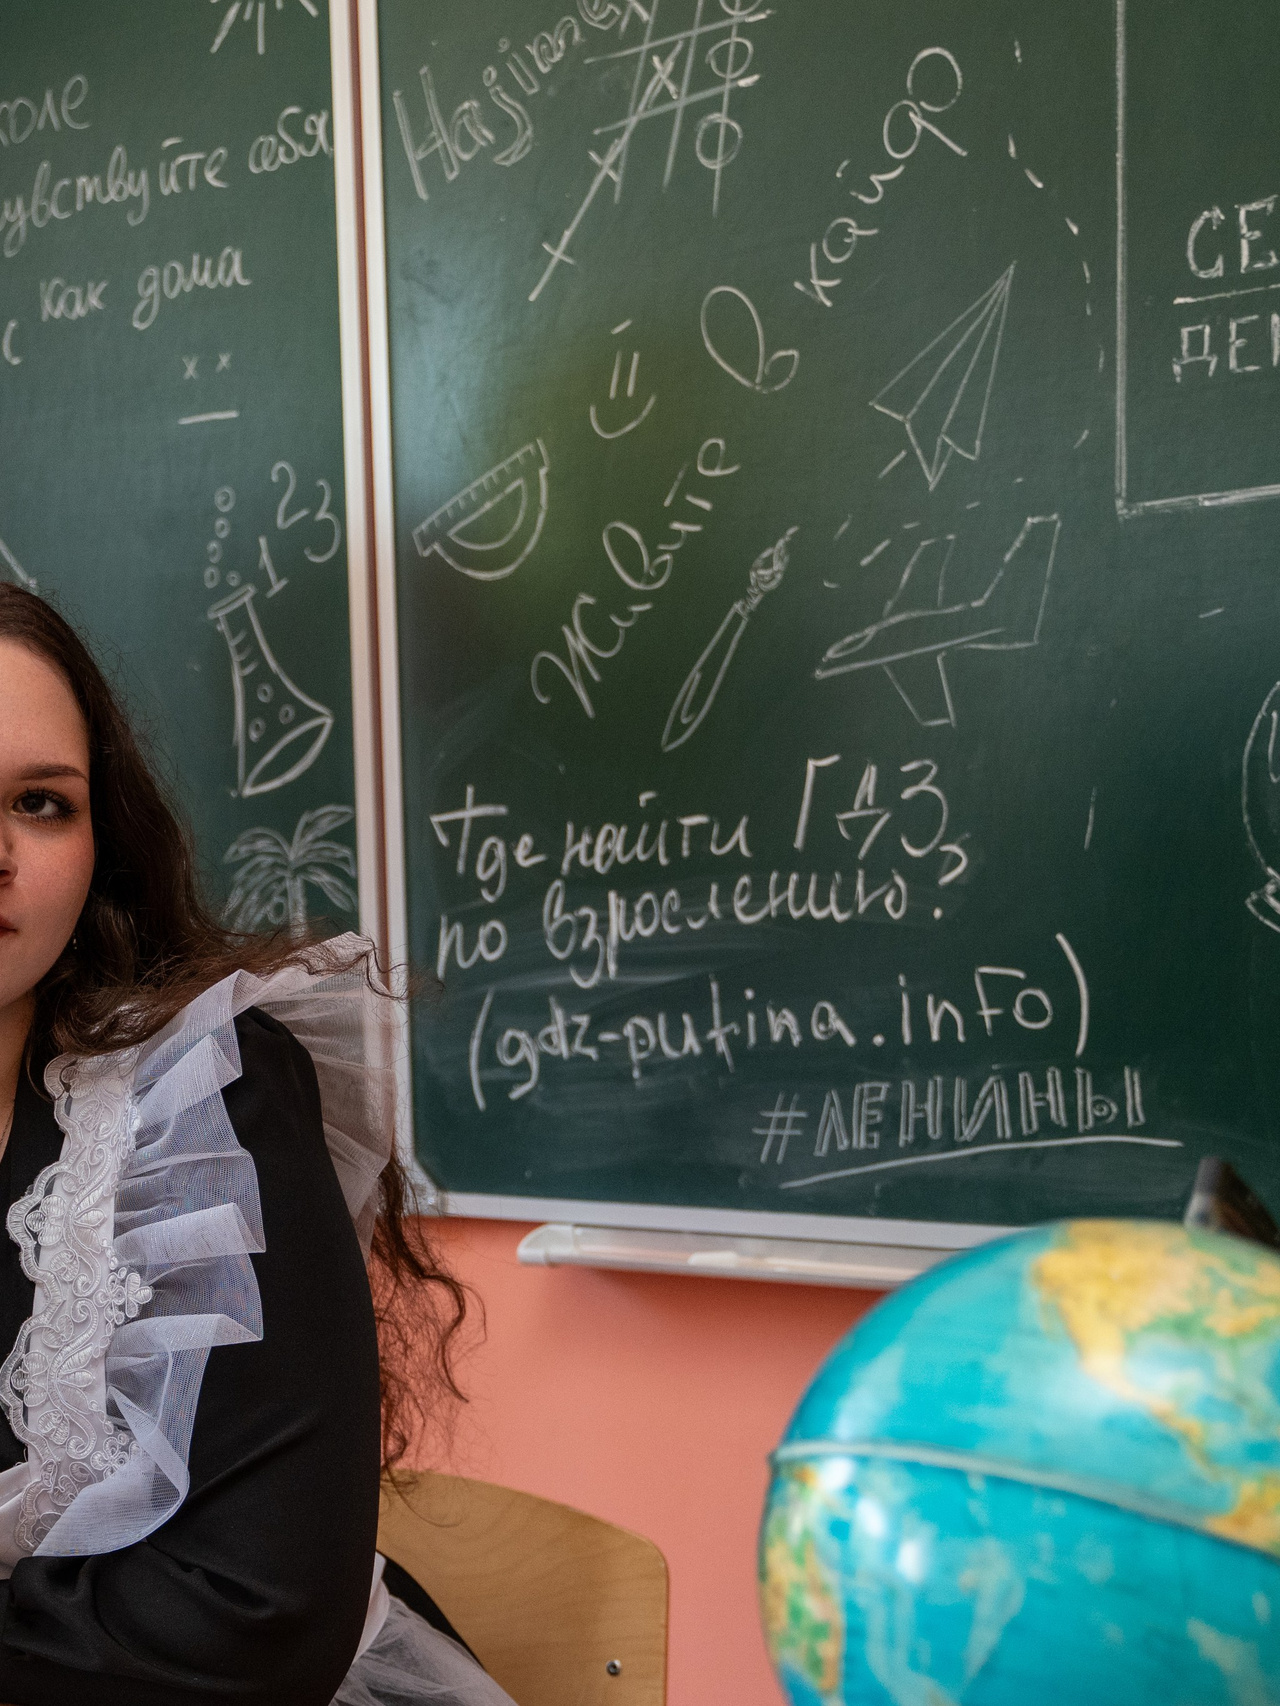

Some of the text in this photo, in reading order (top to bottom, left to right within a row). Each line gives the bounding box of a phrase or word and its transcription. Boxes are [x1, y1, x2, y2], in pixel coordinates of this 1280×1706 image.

[248, 105, 334, 174] себя
[131, 245, 253, 331] дома
[530, 437, 741, 718] Живите
[794, 45, 968, 308] кайф
[560, 792, 754, 874] найти
[794, 754, 951, 860] ГДЗ
[437, 913, 508, 979] по
[752, 1064, 1147, 1165] #ЛЕНИНЫ
